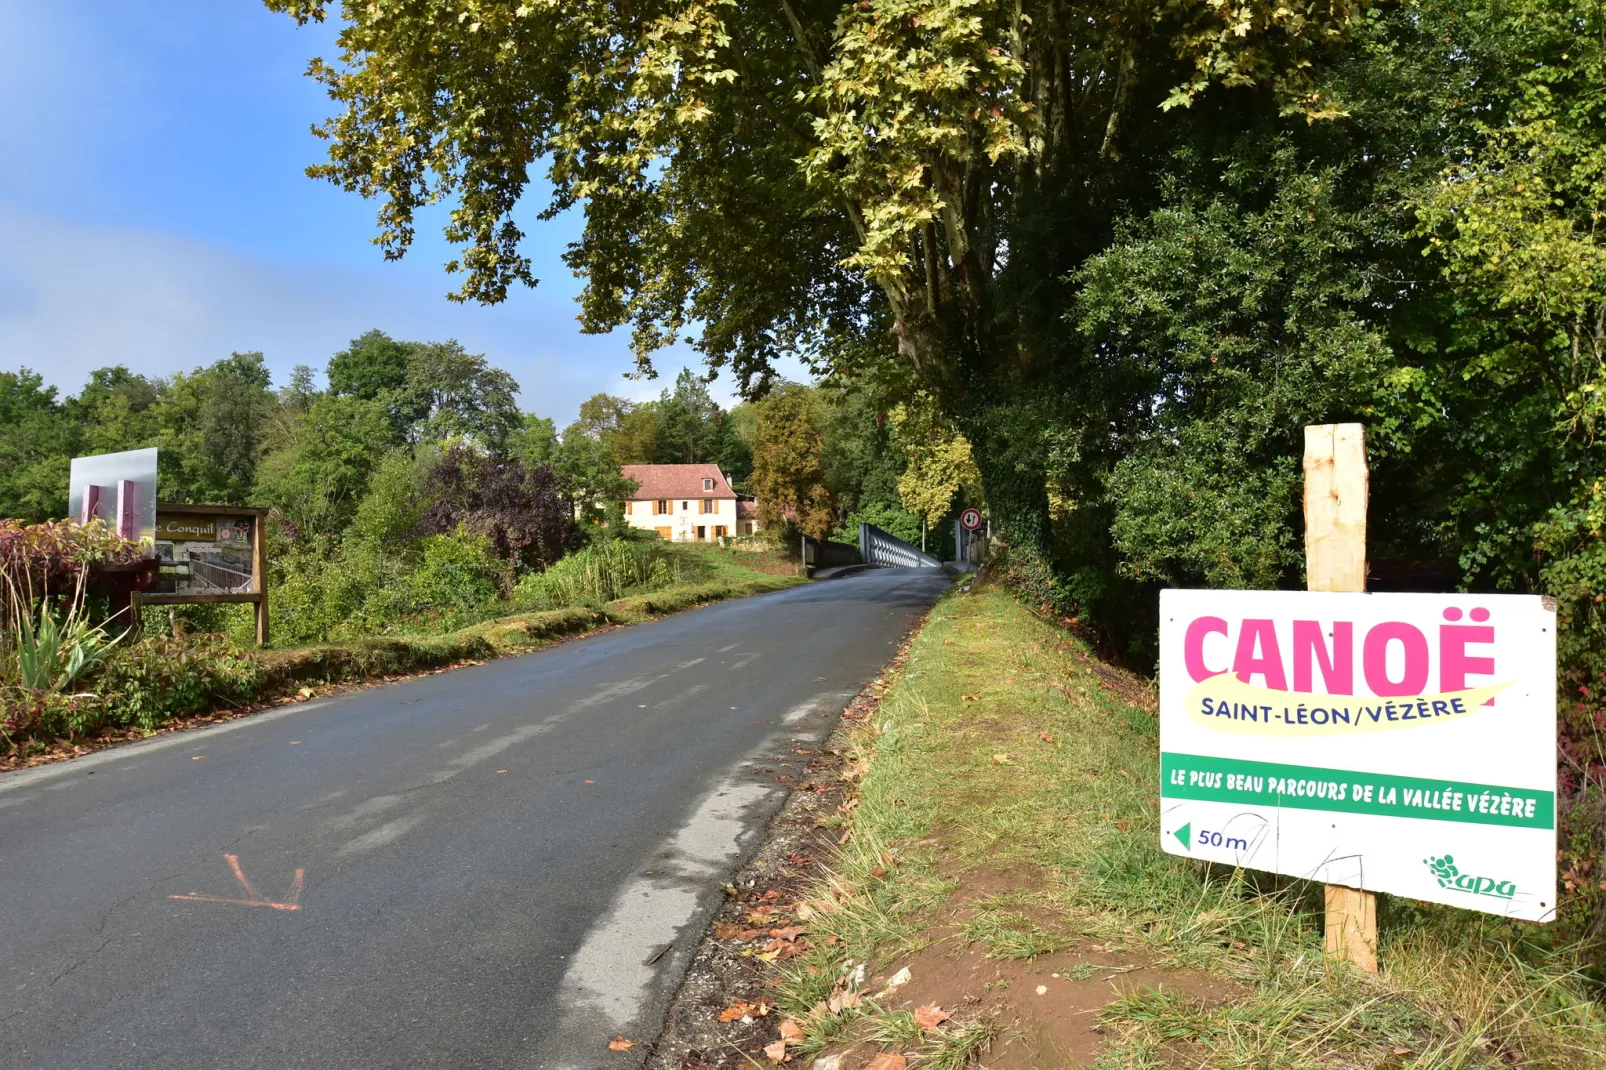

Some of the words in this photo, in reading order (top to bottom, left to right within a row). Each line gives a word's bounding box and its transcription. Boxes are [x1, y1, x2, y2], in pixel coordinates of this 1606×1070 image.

[166, 521, 213, 537] Conquil
[1184, 606, 1495, 707] CANOË
[1201, 697, 1467, 726] SAINT-LÉON/VÉZÈRE
[1170, 769, 1186, 786] LE
[1189, 771, 1222, 789] PLUS
[1226, 774, 1264, 793] BEAU
[1268, 777, 1348, 801] PARCOURS
[1352, 784, 1374, 803] DE
[1378, 786, 1397, 805] LA
[1403, 788, 1463, 811] VALLÉE
[1467, 790, 1537, 818] VÉZÈRE
